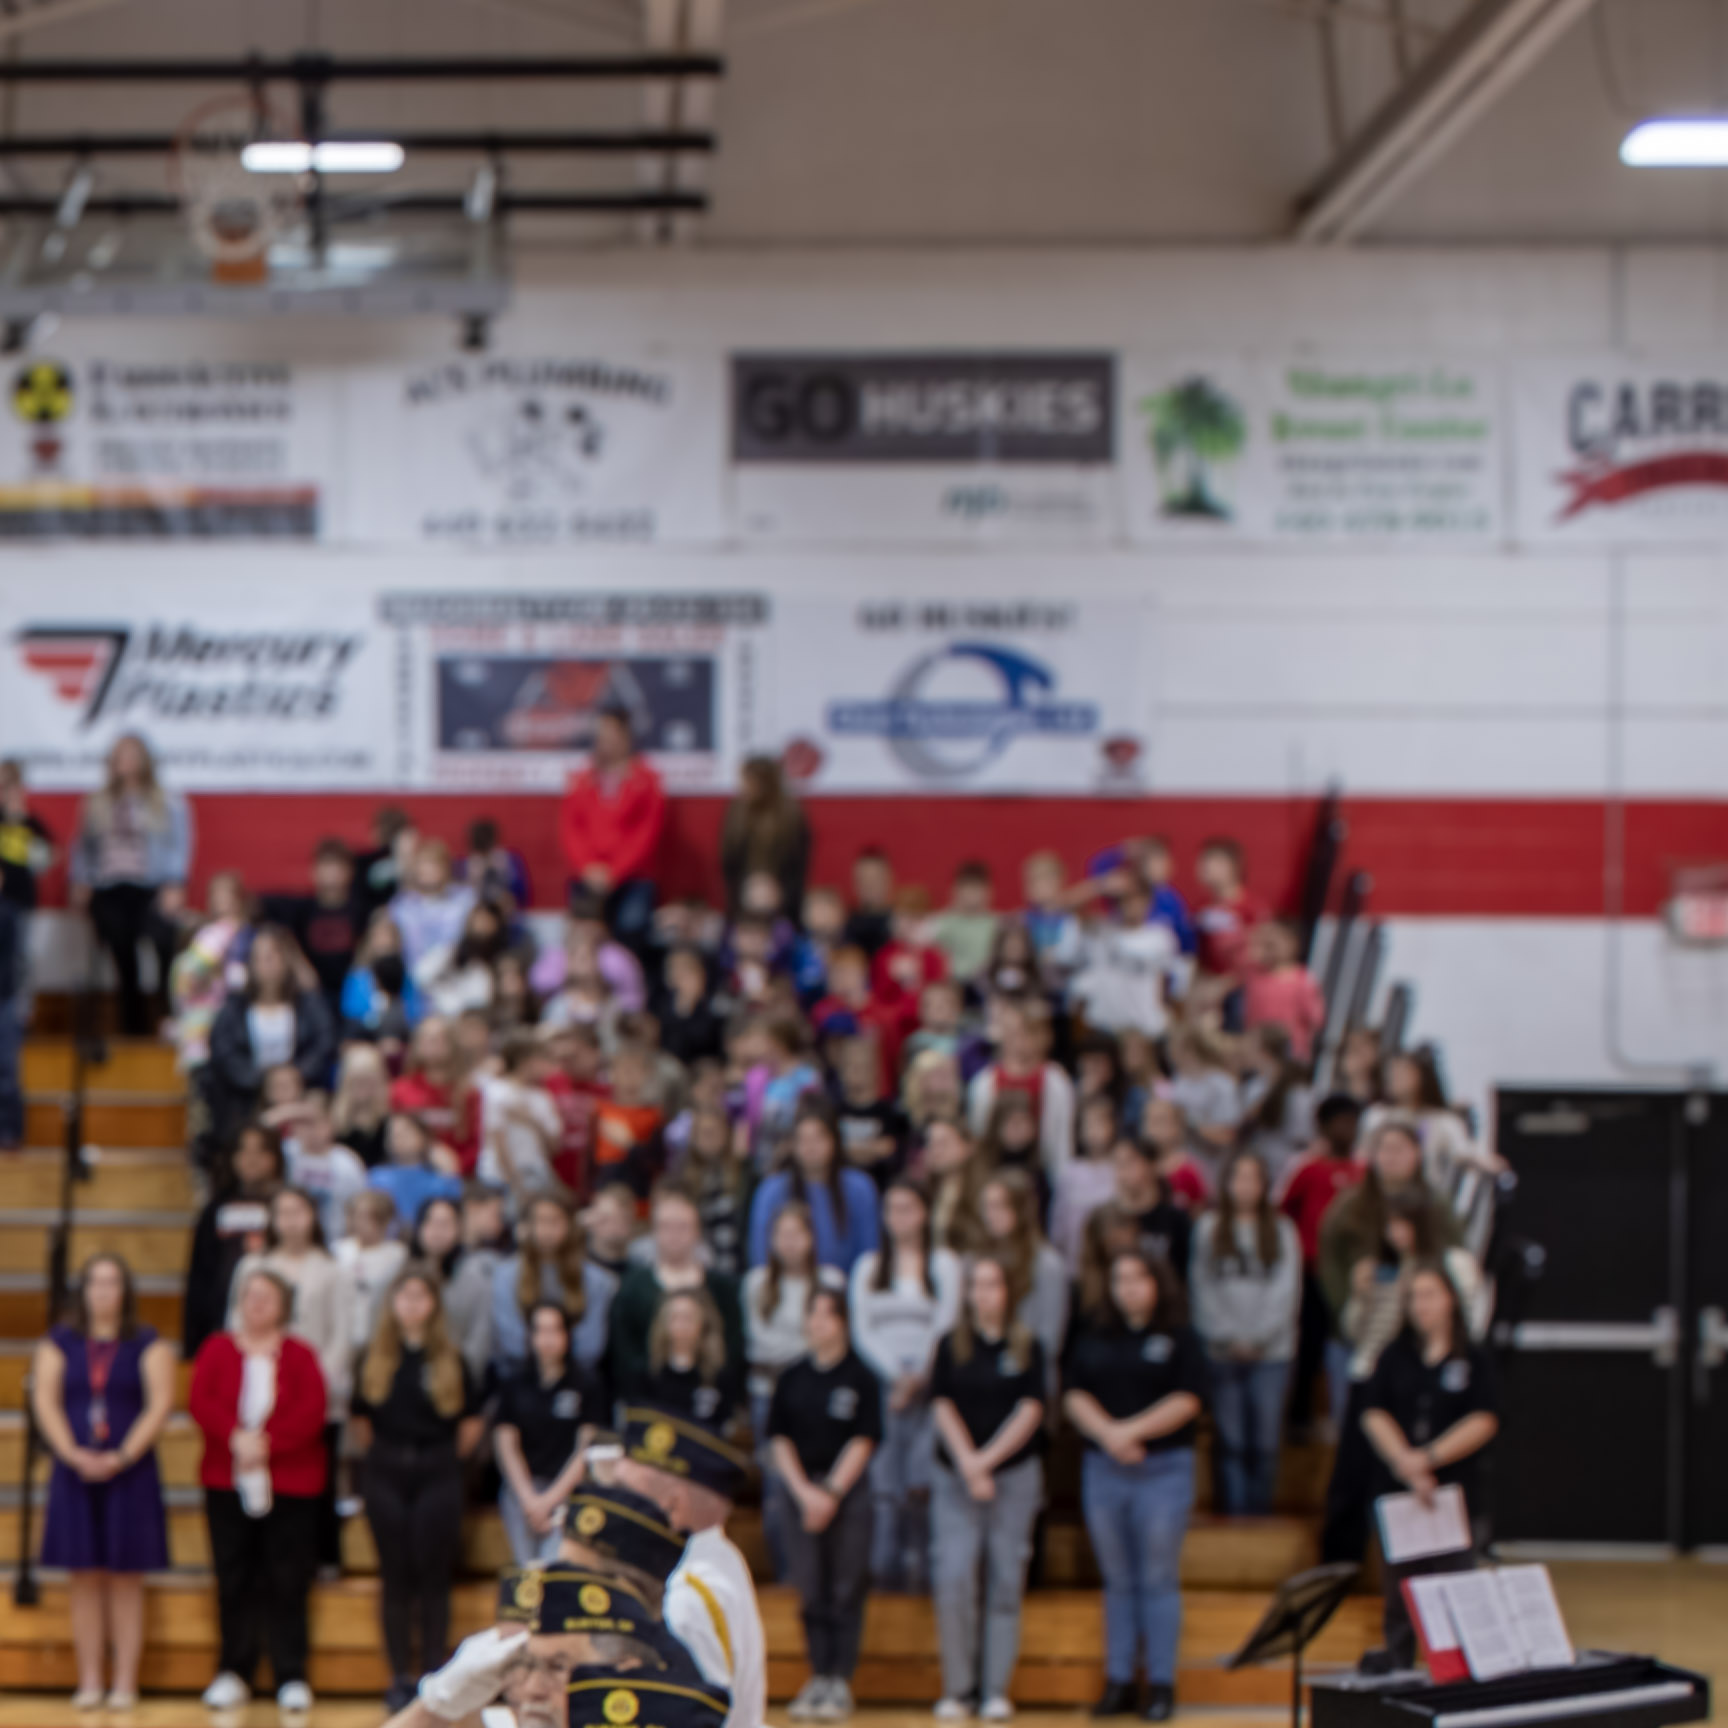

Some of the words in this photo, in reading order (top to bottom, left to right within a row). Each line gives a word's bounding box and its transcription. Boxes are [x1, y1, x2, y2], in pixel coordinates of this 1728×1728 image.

[747, 377, 854, 440] GO
[865, 386, 1098, 430] HUSKIES
[132, 622, 364, 674] Mercury
[114, 681, 341, 732] Plastics
